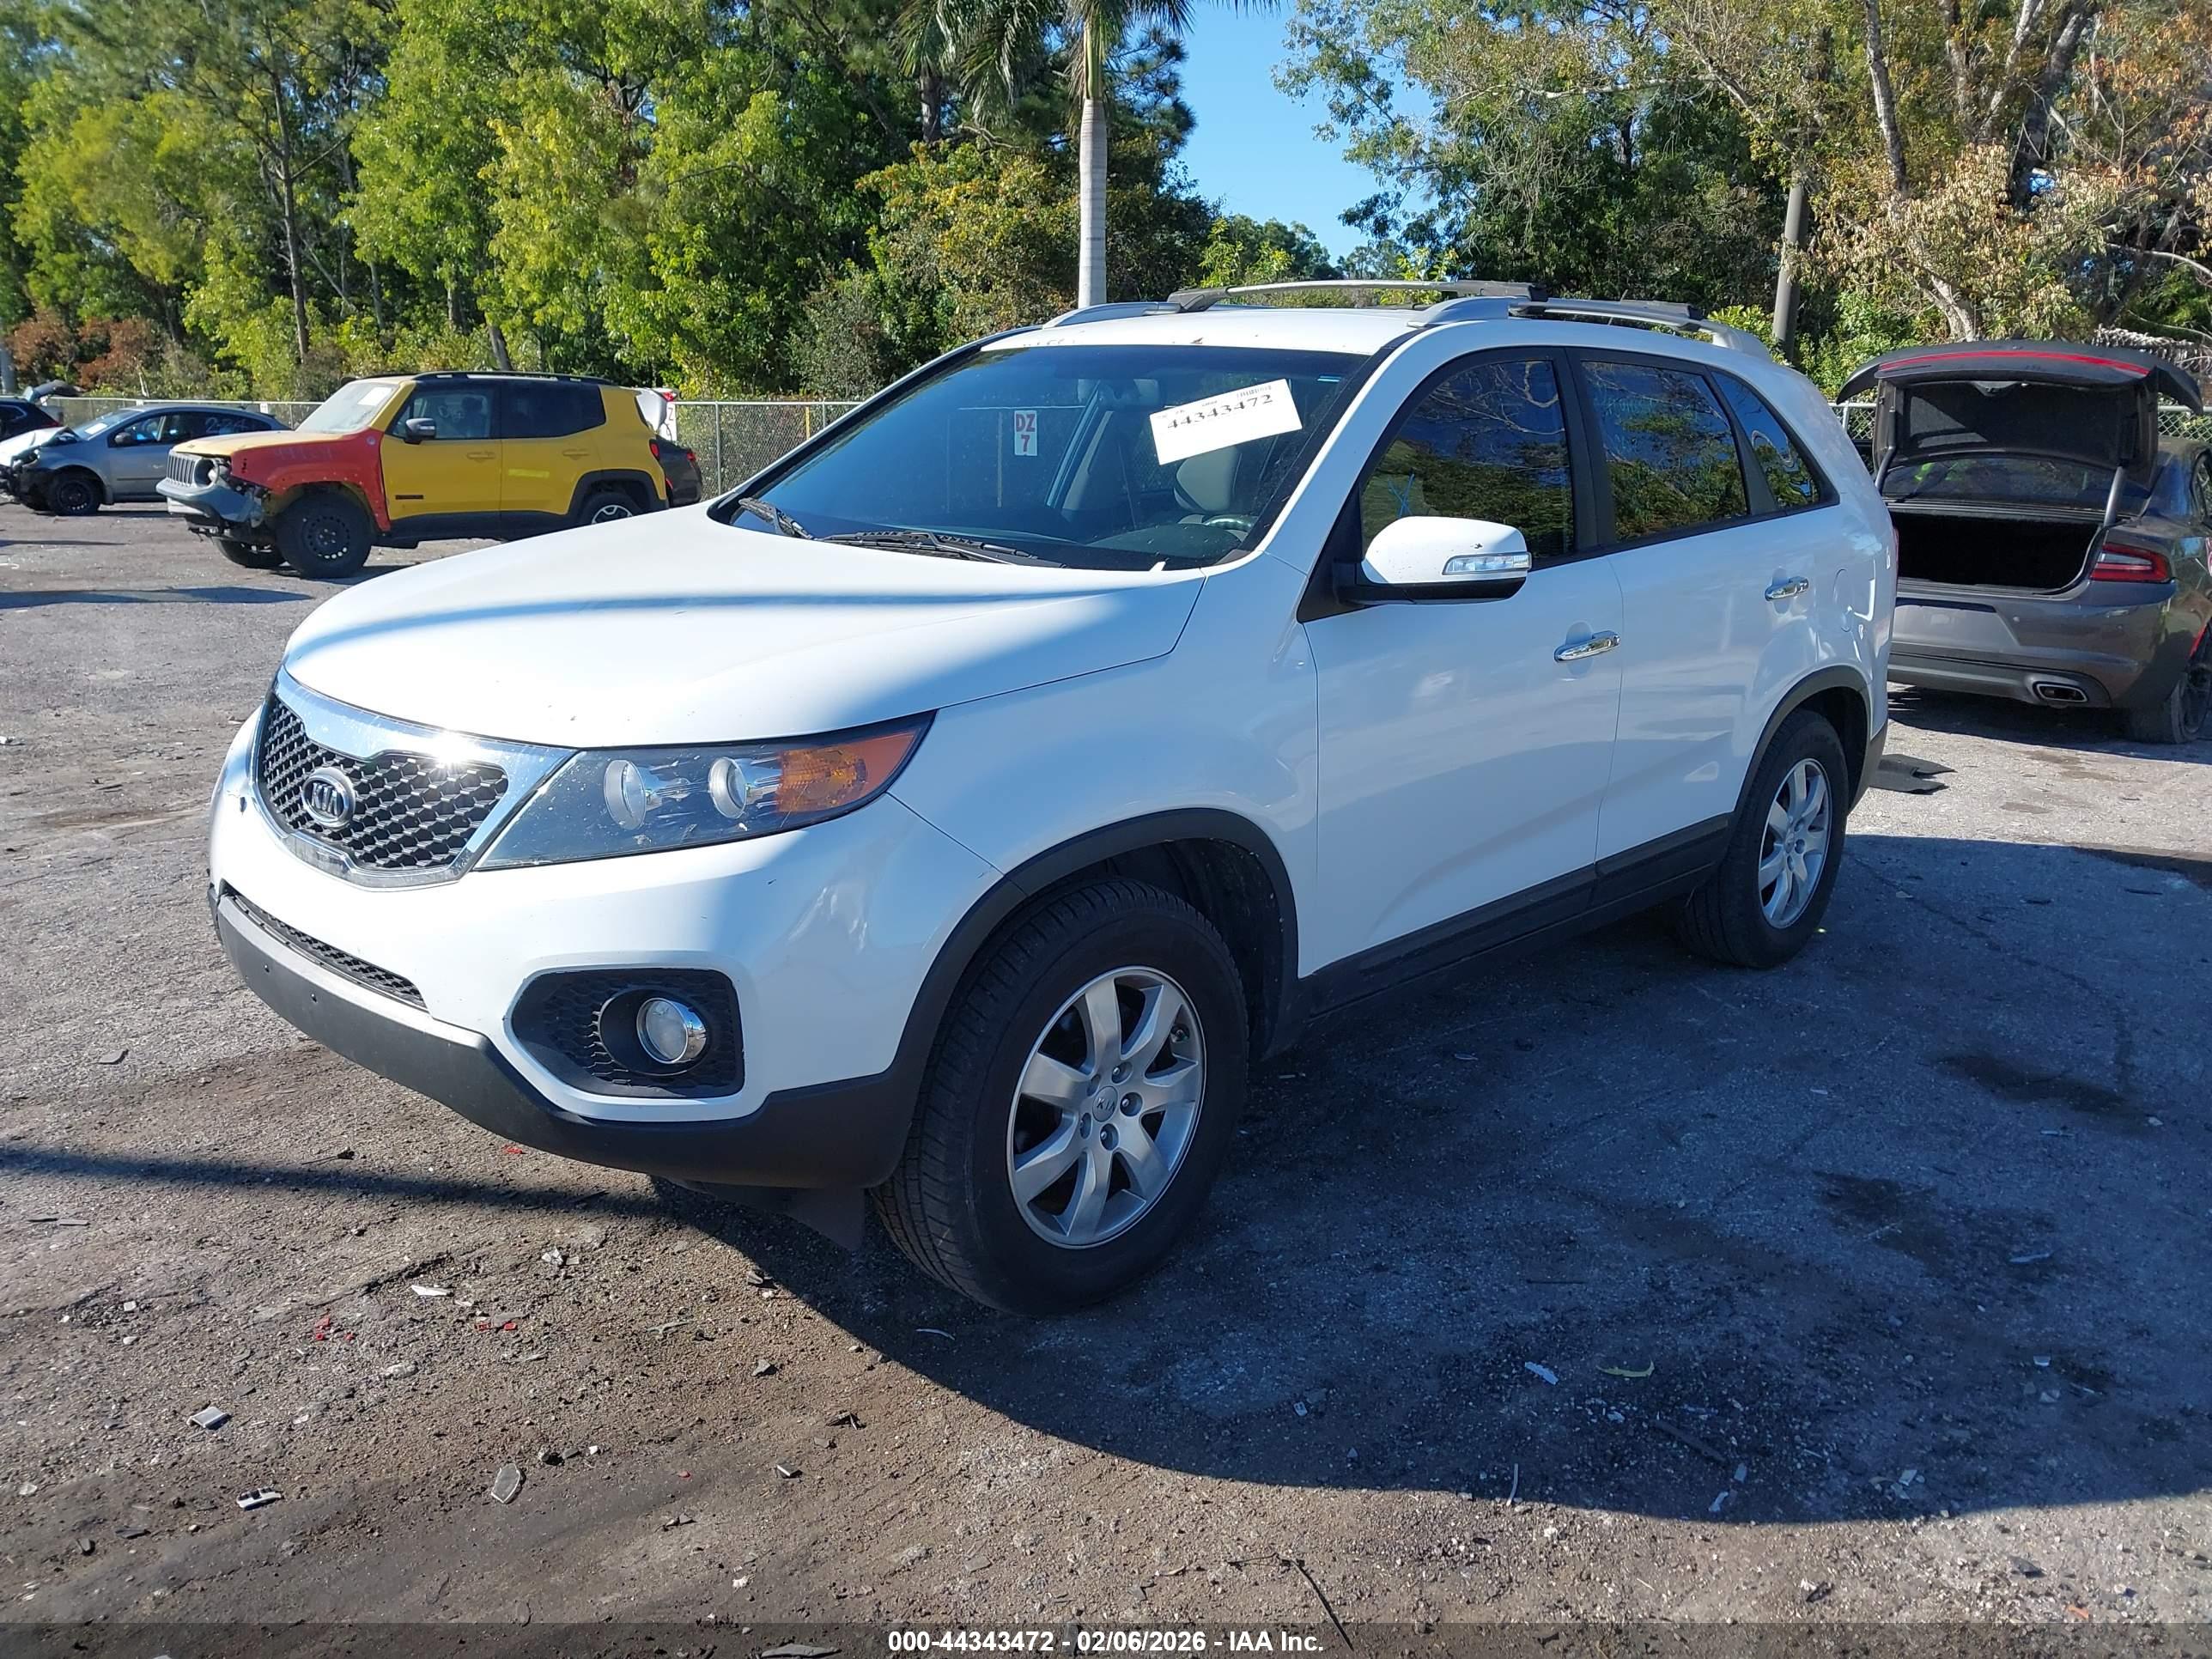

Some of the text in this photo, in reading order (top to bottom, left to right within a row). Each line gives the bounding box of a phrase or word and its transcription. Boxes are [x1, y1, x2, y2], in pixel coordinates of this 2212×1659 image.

[1168, 394, 1273, 428] 44343472
[1015, 413, 1036, 432] DZ
[1021, 434, 1030, 453] 7
[311, 782, 337, 816] KIA
[1097, 1097, 1115, 1112] KIA
